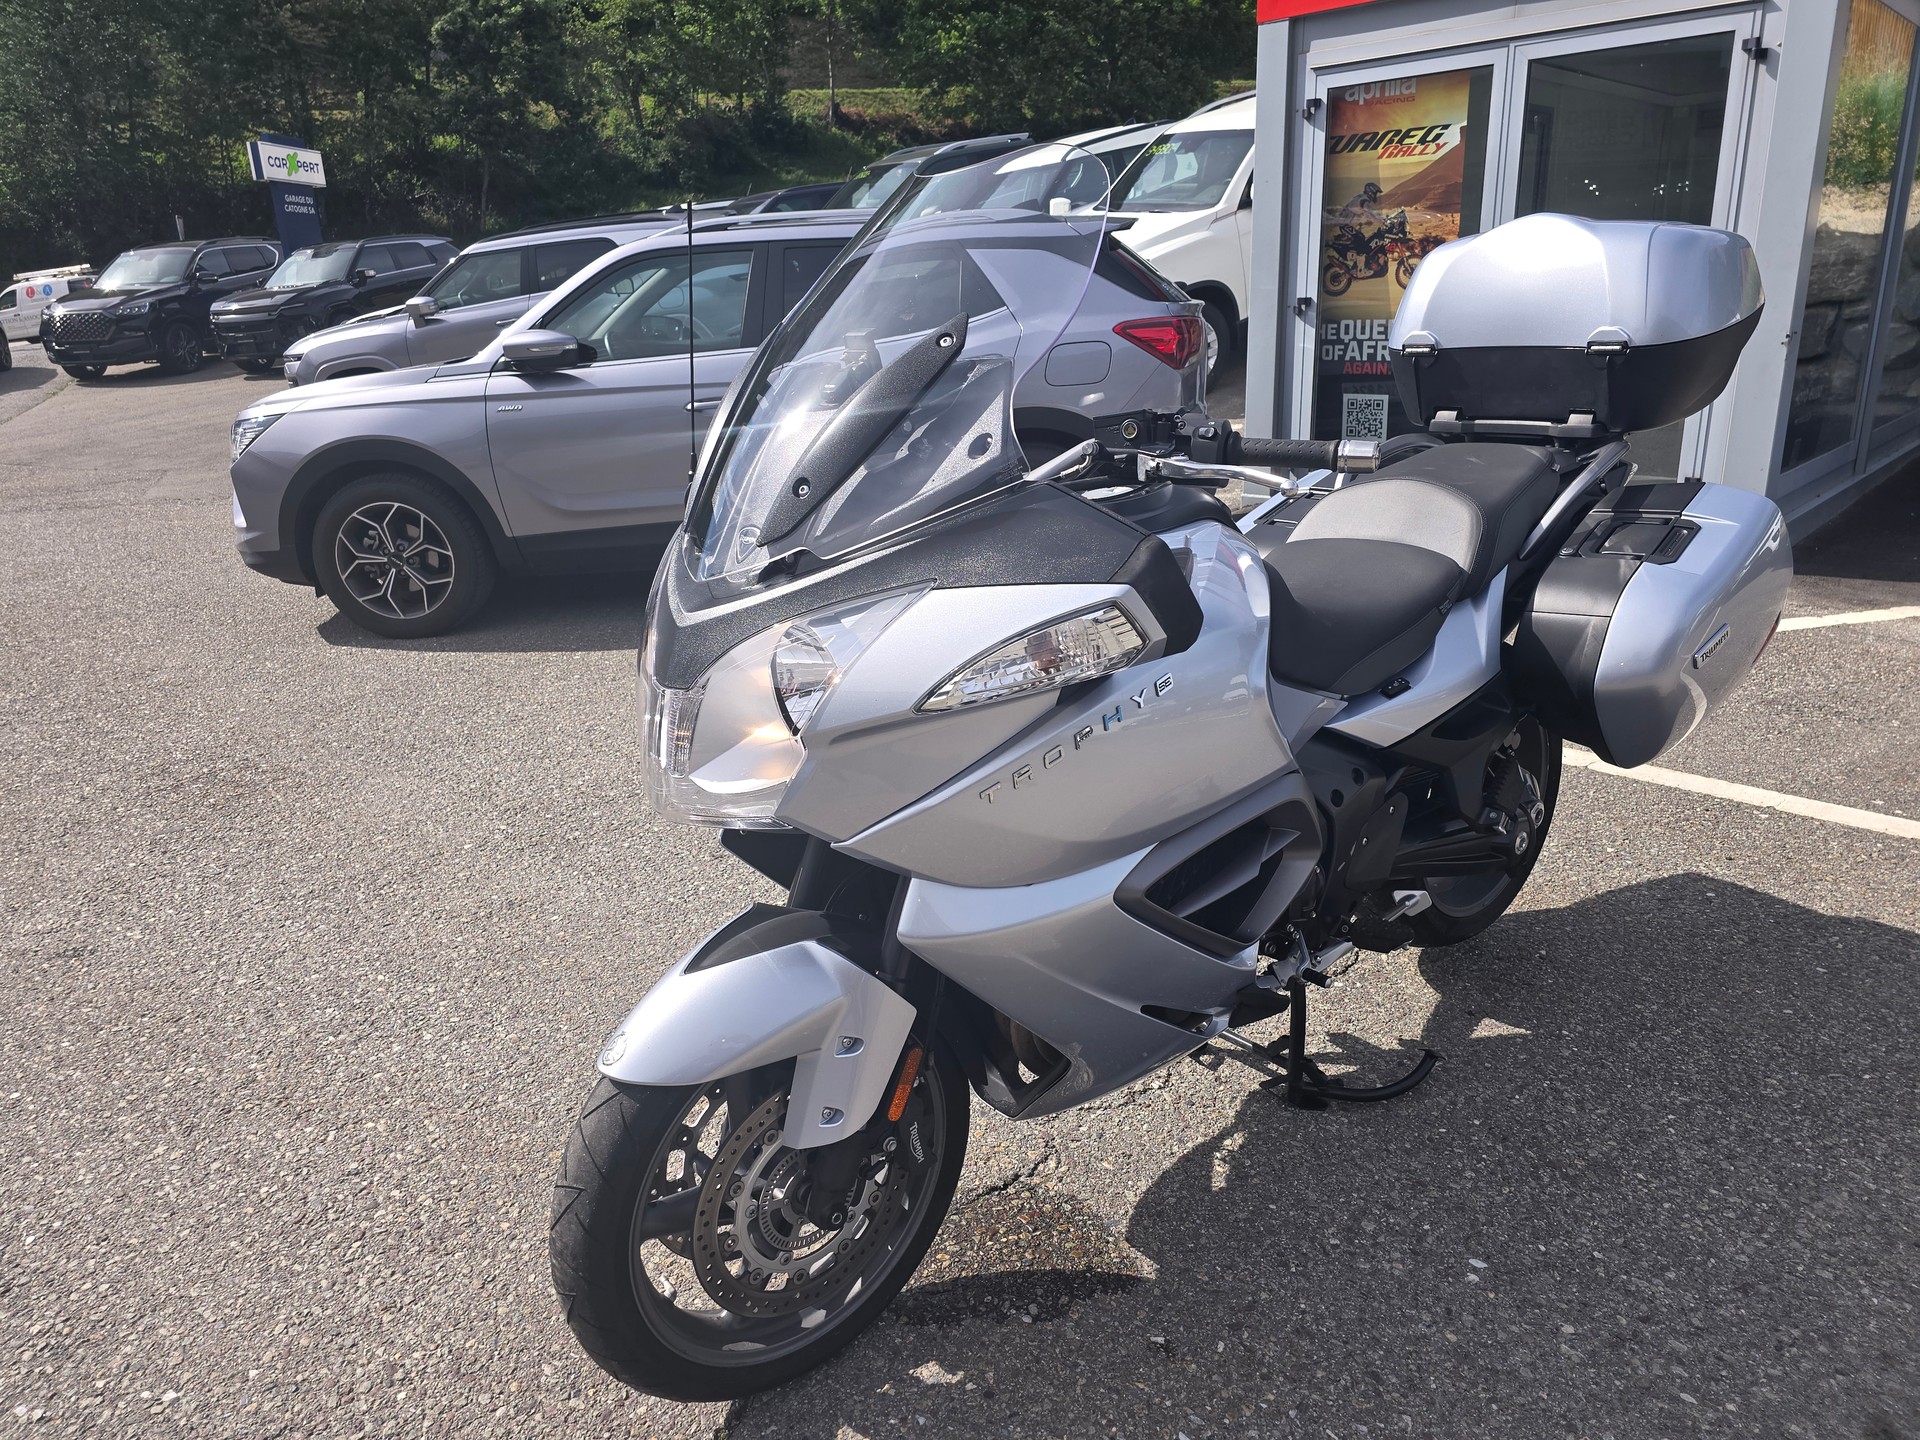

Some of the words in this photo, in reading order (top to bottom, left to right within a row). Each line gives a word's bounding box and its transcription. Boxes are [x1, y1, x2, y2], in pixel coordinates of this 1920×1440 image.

[1329, 123, 1453, 155] UAREG
[1376, 141, 1449, 160] RALLY
[284, 194, 305, 203] GARAGE
[284, 204, 309, 214] CATOGNE
[1319, 323, 1338, 339] HE
[1340, 319, 1394, 343] QUE
[1321, 344, 1345, 361] OF
[1344, 340, 1392, 361] AFR
[1343, 362, 1392, 375] AGAIN.
[1700, 630, 1729, 662] TRIUMPH
[979, 687, 1147, 804] TROPHY
[910, 1122, 924, 1162] TRIUMPH
